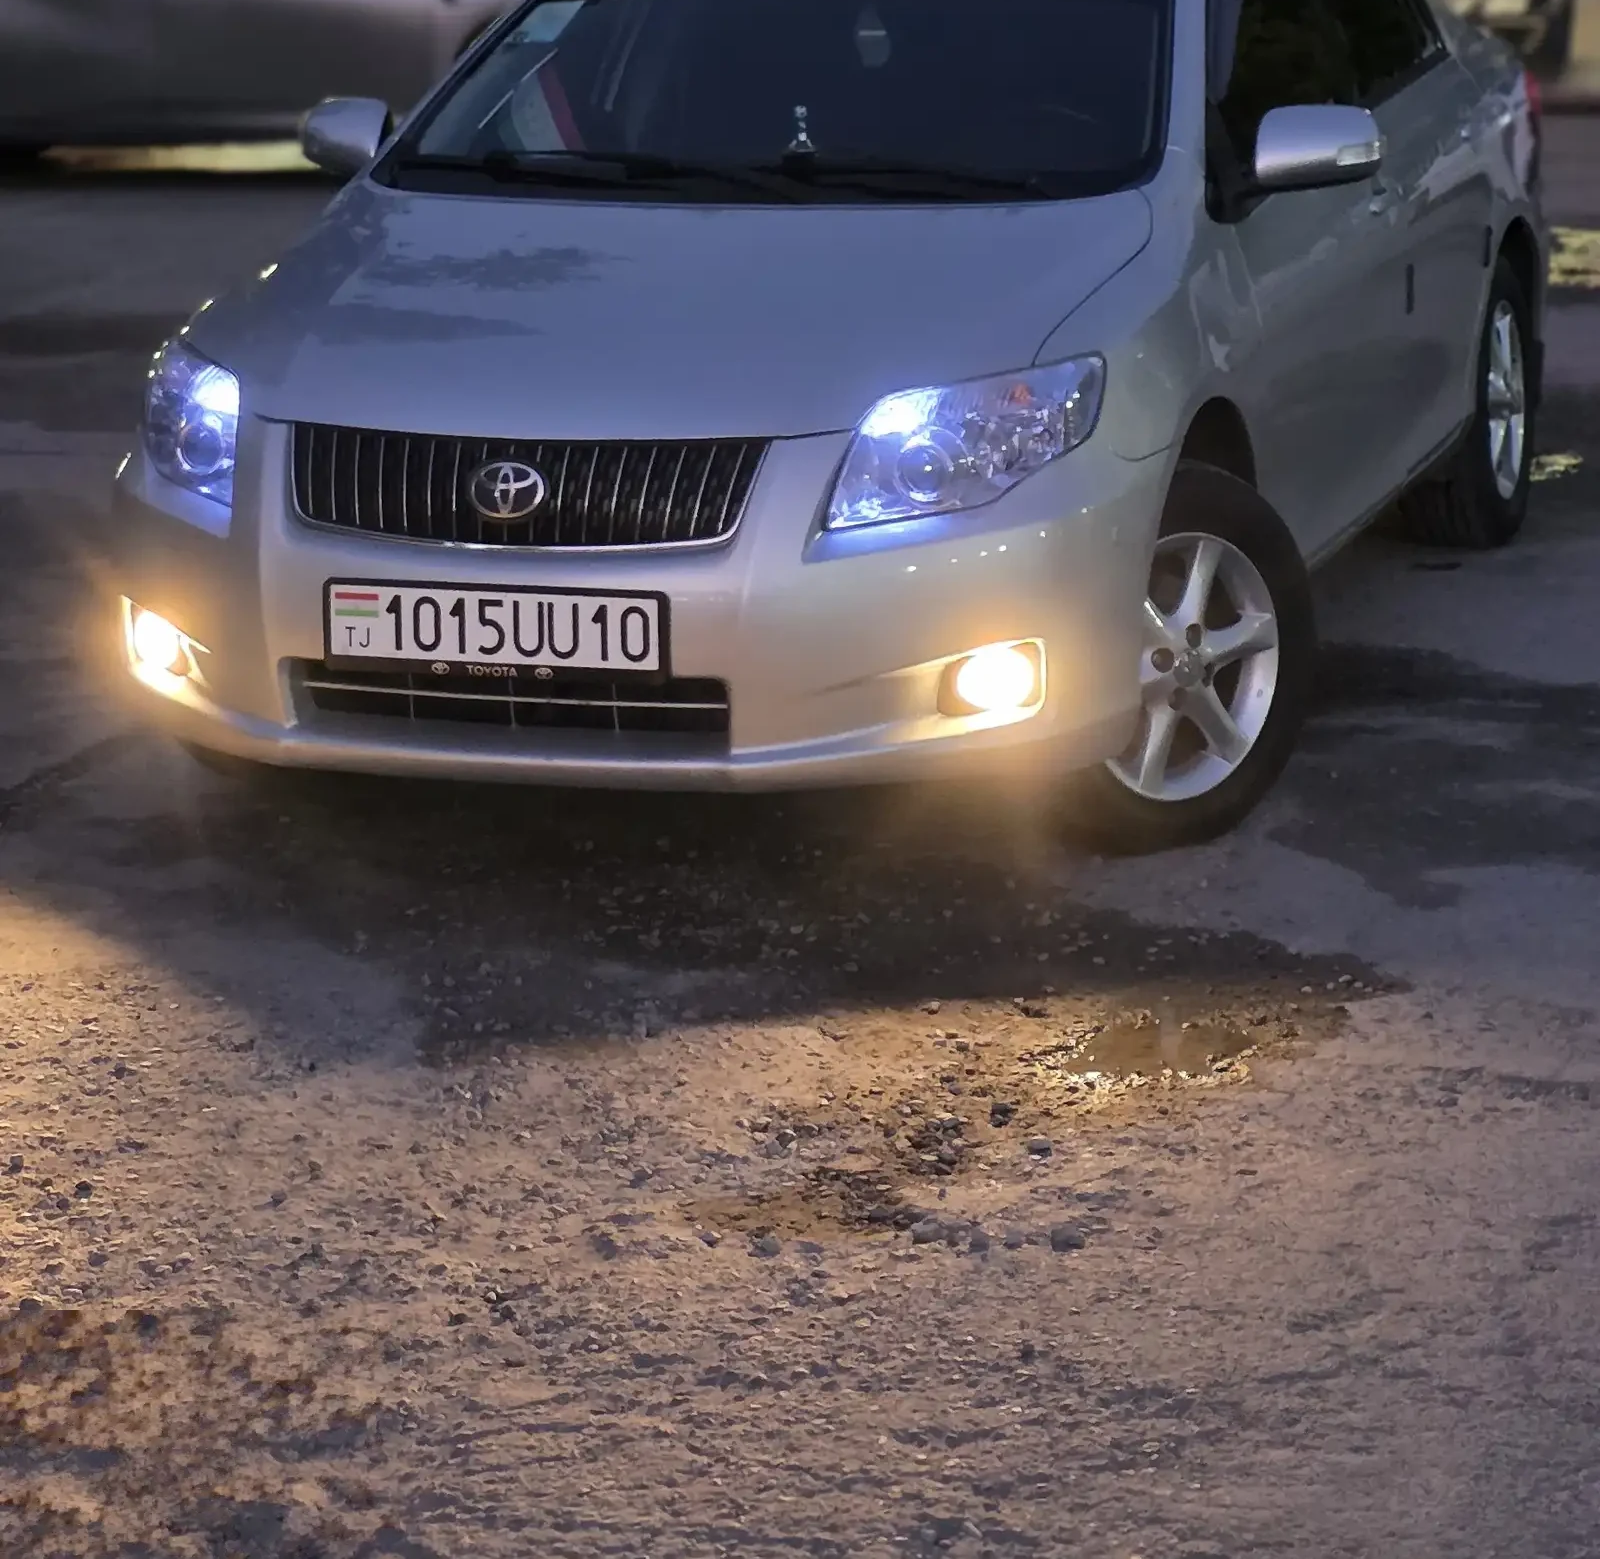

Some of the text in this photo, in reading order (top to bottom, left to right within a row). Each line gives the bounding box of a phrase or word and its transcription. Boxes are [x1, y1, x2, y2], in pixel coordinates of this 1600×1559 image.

[345, 626, 370, 648] TJ
[386, 594, 650, 663] 1015UU10
[465, 664, 518, 678] TOYOTA
